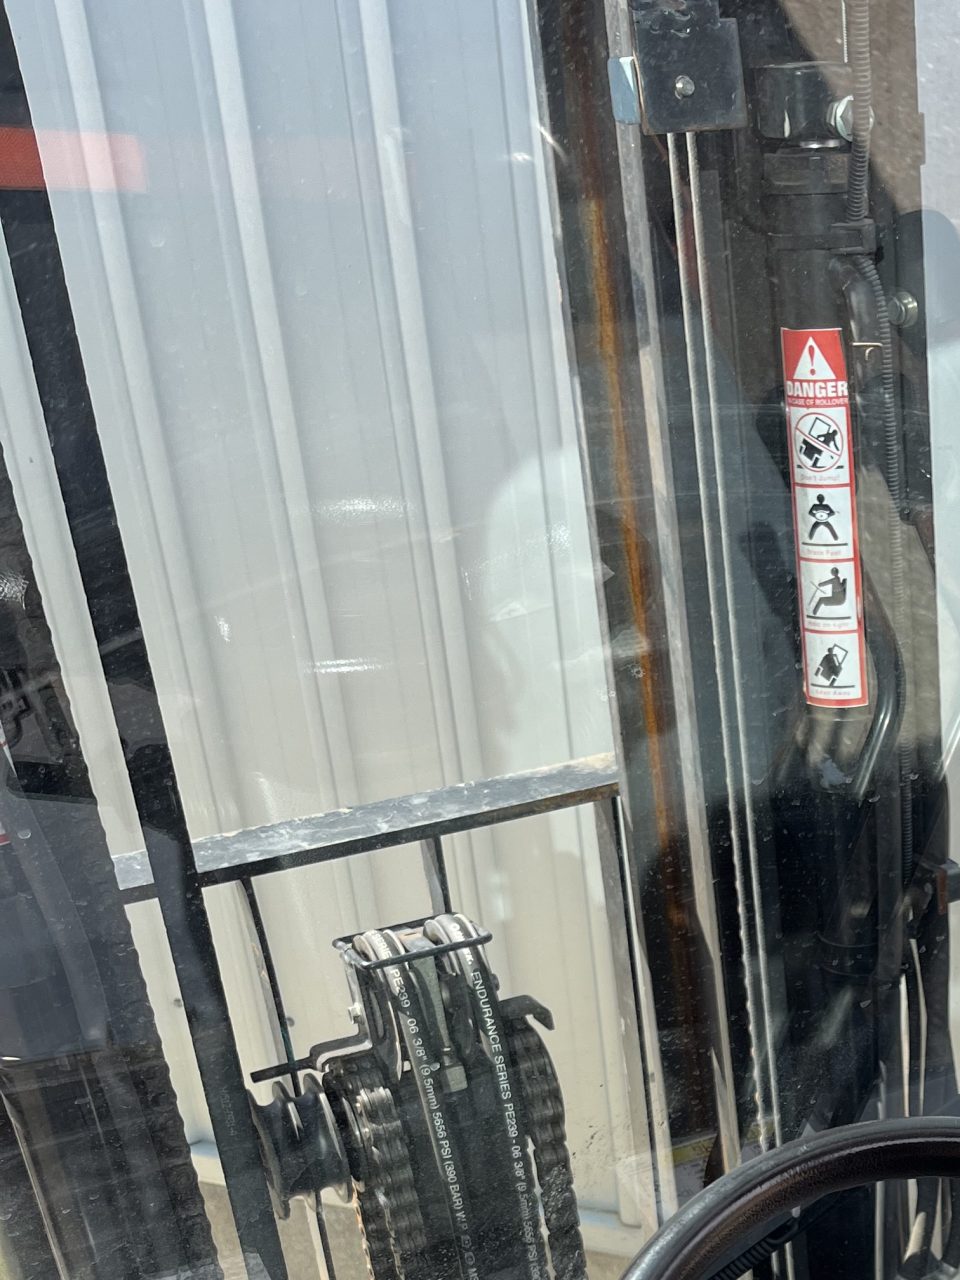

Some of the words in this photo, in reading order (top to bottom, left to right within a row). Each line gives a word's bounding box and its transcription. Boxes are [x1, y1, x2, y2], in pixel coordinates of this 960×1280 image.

[786, 380, 848, 397] DANGER
[371, 931, 393, 961] SERIE
[390, 967, 411, 1009] PE239
[406, 1018, 419, 1034] 06
[412, 1038, 428, 1061] 3/8"
[472, 971, 502, 1053] ENDURANCE
[494, 1055, 511, 1100] SERIES
[504, 1103, 518, 1138] PE239
[511, 1145, 521, 1159] 06
[420, 1064, 440, 1110] (9.5mm)
[433, 1112, 447, 1138] 5656
[440, 1140, 452, 1159] PSI
[443, 1161, 457, 1182] (390
[450, 1184, 464, 1210] BAR)
